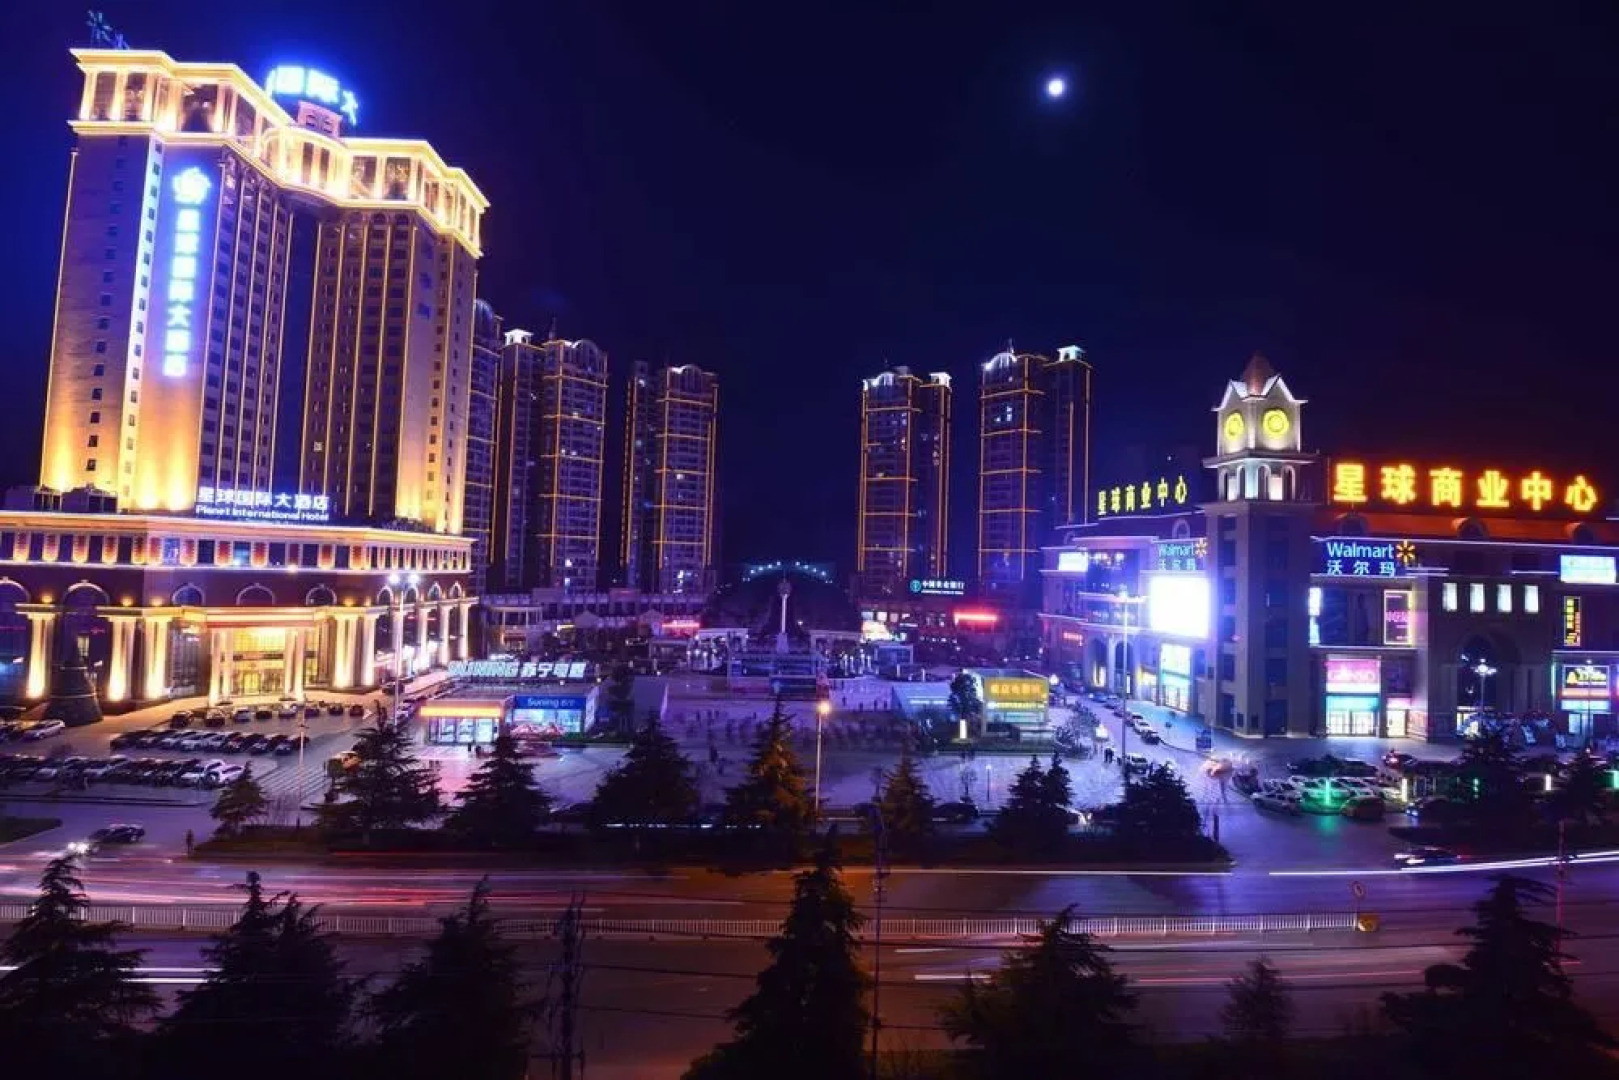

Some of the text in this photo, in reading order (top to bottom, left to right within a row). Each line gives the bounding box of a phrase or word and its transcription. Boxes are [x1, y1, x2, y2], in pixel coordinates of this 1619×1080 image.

[1097, 475, 1188, 516] 星球商业中心
[1333, 463, 1598, 512] 星球商业中心
[197, 486, 330, 510] 星球国际大酒店
[196, 504, 330, 521] Planet International Hotel
[1158, 542, 1194, 556] Walmart
[1326, 542, 1394, 559] Walmart
[1327, 559, 1396, 577] 沃尔玛
